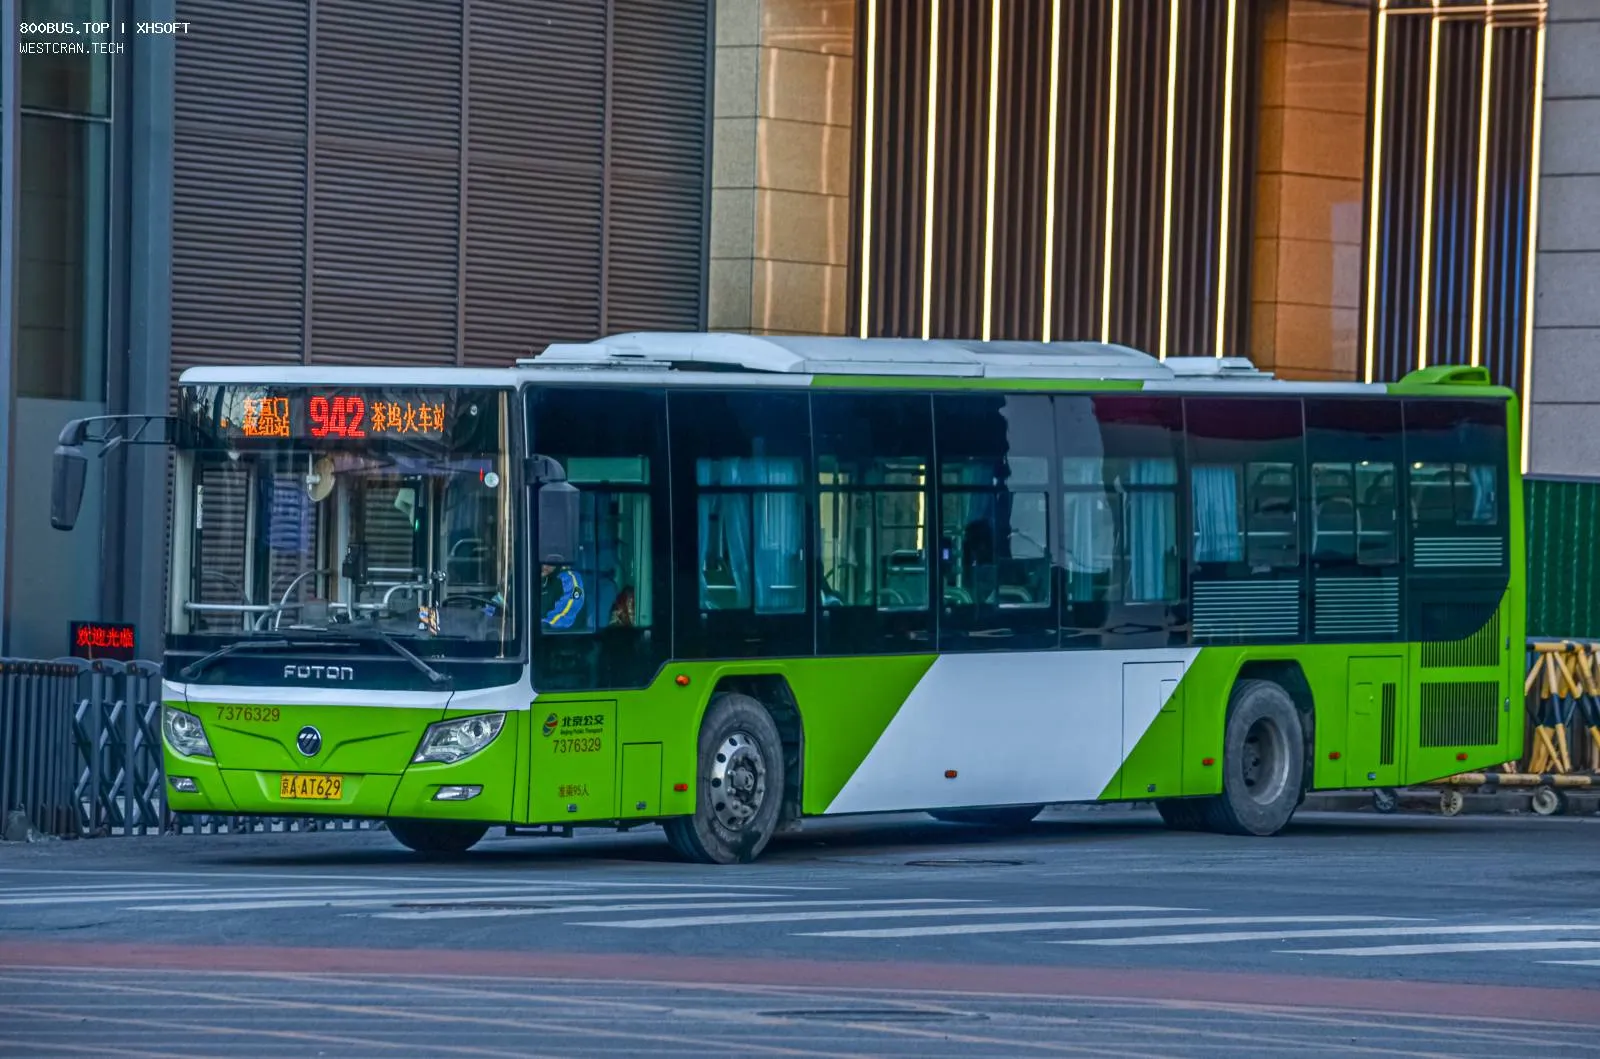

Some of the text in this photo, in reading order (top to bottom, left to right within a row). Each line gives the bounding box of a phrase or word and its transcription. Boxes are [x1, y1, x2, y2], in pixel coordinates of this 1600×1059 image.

[310, 396, 365, 437] 942
[77, 625, 135, 648] 欢迎光临
[283, 665, 354, 680] FOTON
[216, 706, 280, 722] 7376329
[561, 714, 604, 727] 北京公交
[553, 737, 602, 754] 7376329
